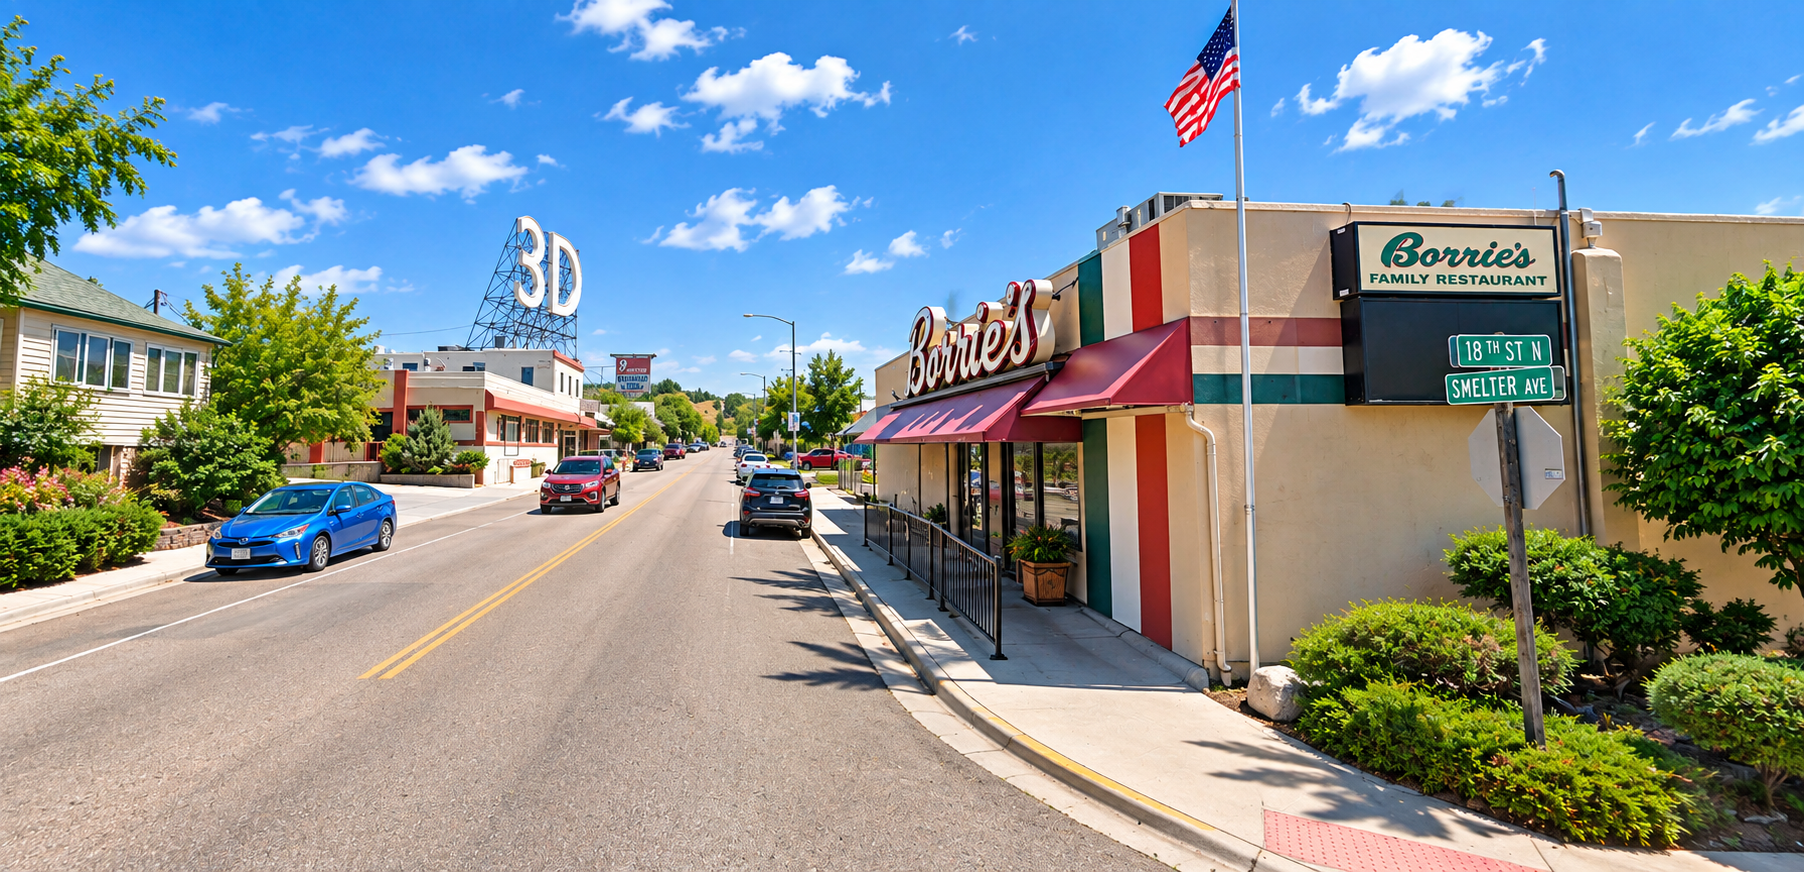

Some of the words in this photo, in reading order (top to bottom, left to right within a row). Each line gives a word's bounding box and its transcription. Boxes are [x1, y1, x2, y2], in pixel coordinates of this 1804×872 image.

[1380, 231, 1536, 269] Borrie's
[513, 215, 583, 317] 3D
[1369, 273, 1430, 285] FAMILY
[1436, 274, 1548, 287] RESTAURANT
[904, 279, 1050, 398] Borrie's
[1505, 340, 1524, 362] ST
[1532, 340, 1542, 361] N
[1451, 375, 1518, 399] SMELTER
[1524, 377, 1548, 396] AVE
